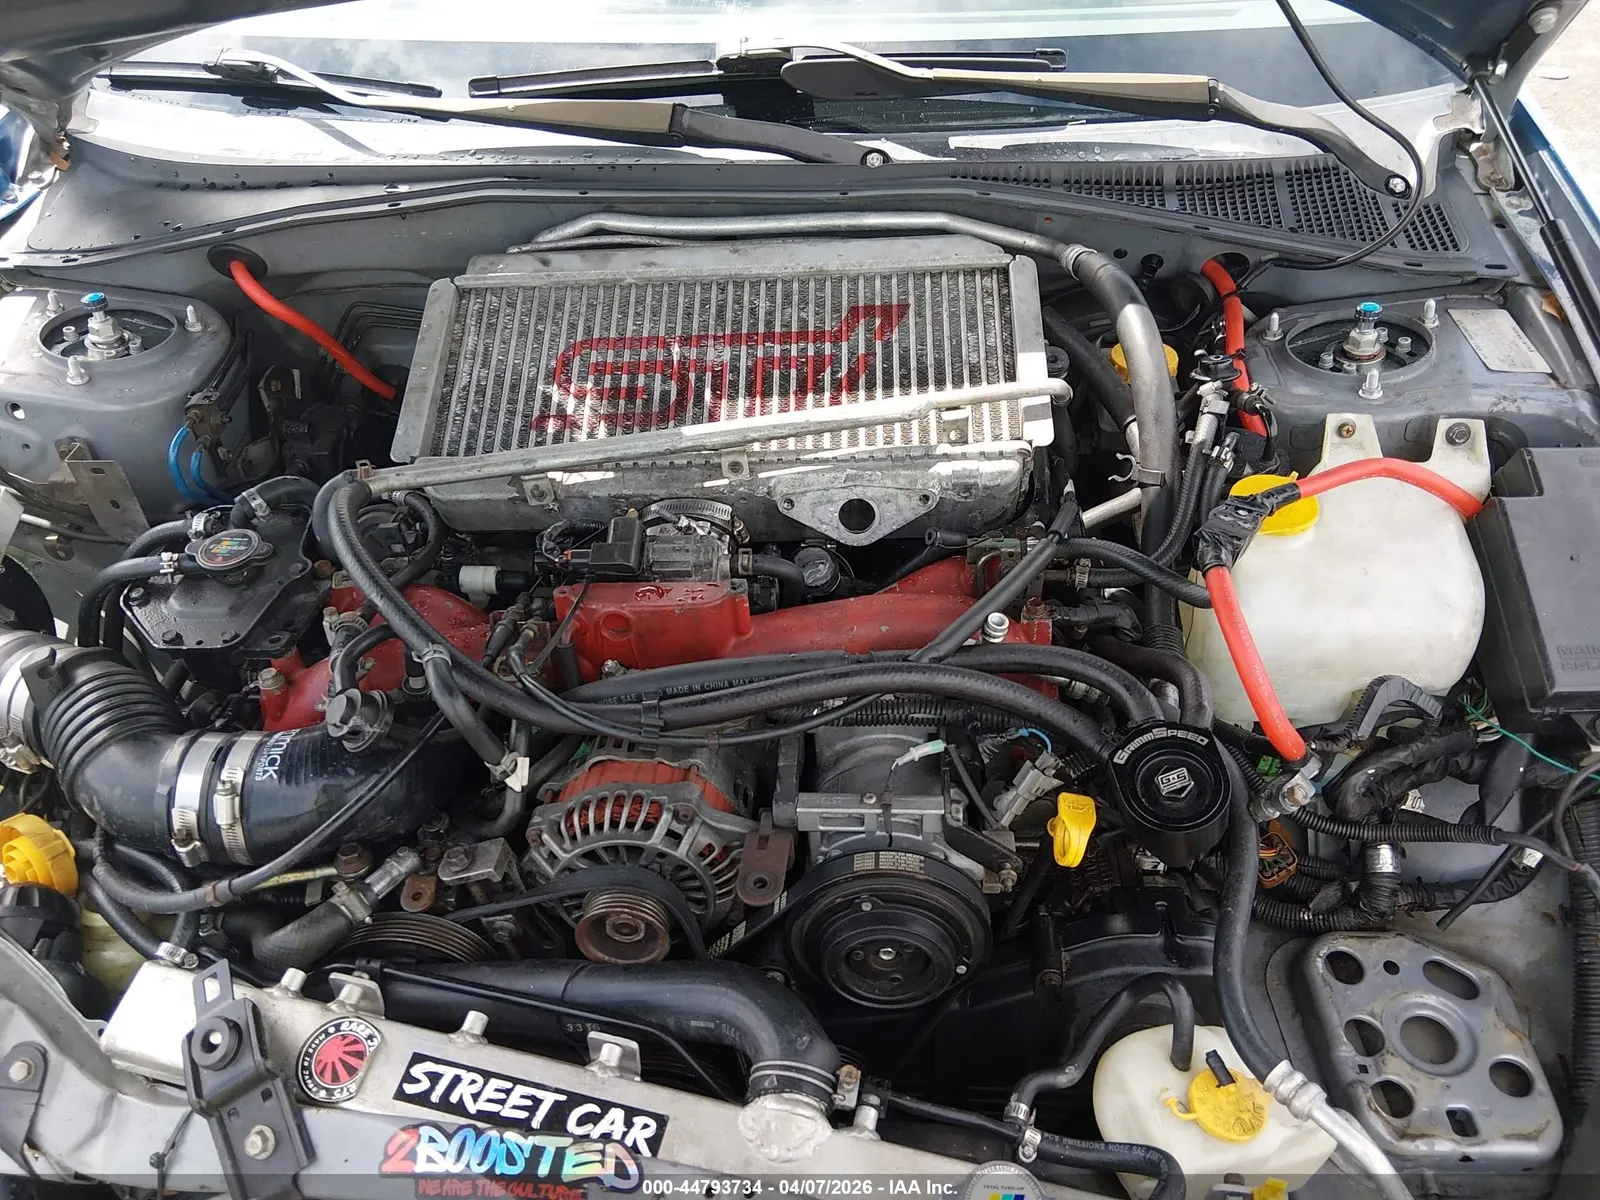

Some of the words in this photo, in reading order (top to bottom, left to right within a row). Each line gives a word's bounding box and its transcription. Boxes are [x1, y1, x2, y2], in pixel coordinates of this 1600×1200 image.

[665, 684, 690, 696] MADE
[692, 682, 702, 692] IN
[704, 679, 730, 691] CHINA
[339, 1021, 372, 1039] RARE
[307, 1033, 326, 1053] MADE
[401, 1060, 568, 1130] STREET
[566, 1102, 657, 1158] CAR
[1062, 1135, 1105, 1150] EMISSIONS
[1108, 1143, 1130, 1153] HOSE
[418, 1178, 441, 1195] WE
[442, 1178, 473, 1196] ARE
[475, 1179, 507, 1197] THE
